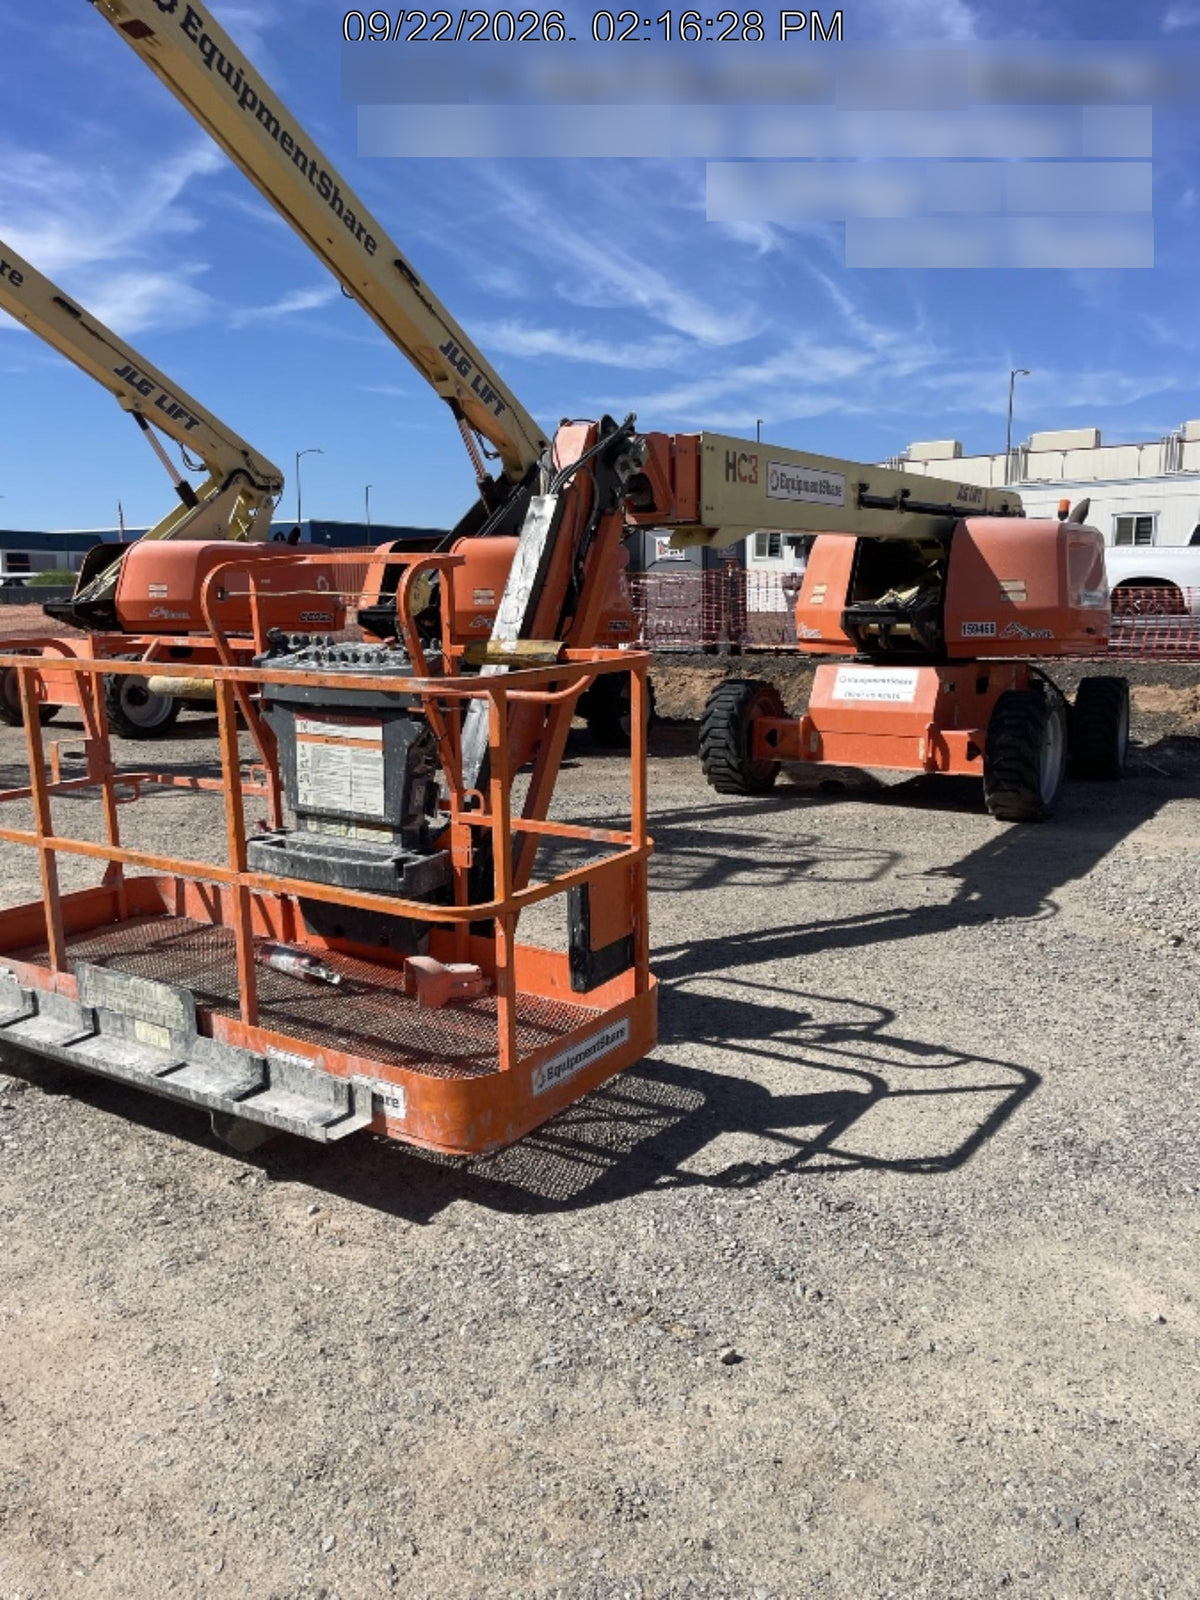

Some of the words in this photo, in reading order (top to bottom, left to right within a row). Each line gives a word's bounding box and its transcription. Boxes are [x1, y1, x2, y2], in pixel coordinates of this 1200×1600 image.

[180, 5, 377, 256] EquipmentShare
[113, 365, 155, 397] JLG
[154, 394, 200, 431] LIFT
[439, 340, 472, 378] JLG
[471, 374, 506, 416] LIFT
[725, 450, 759, 485] HC3
[546, 1027, 625, 1081] EquipmentShare
